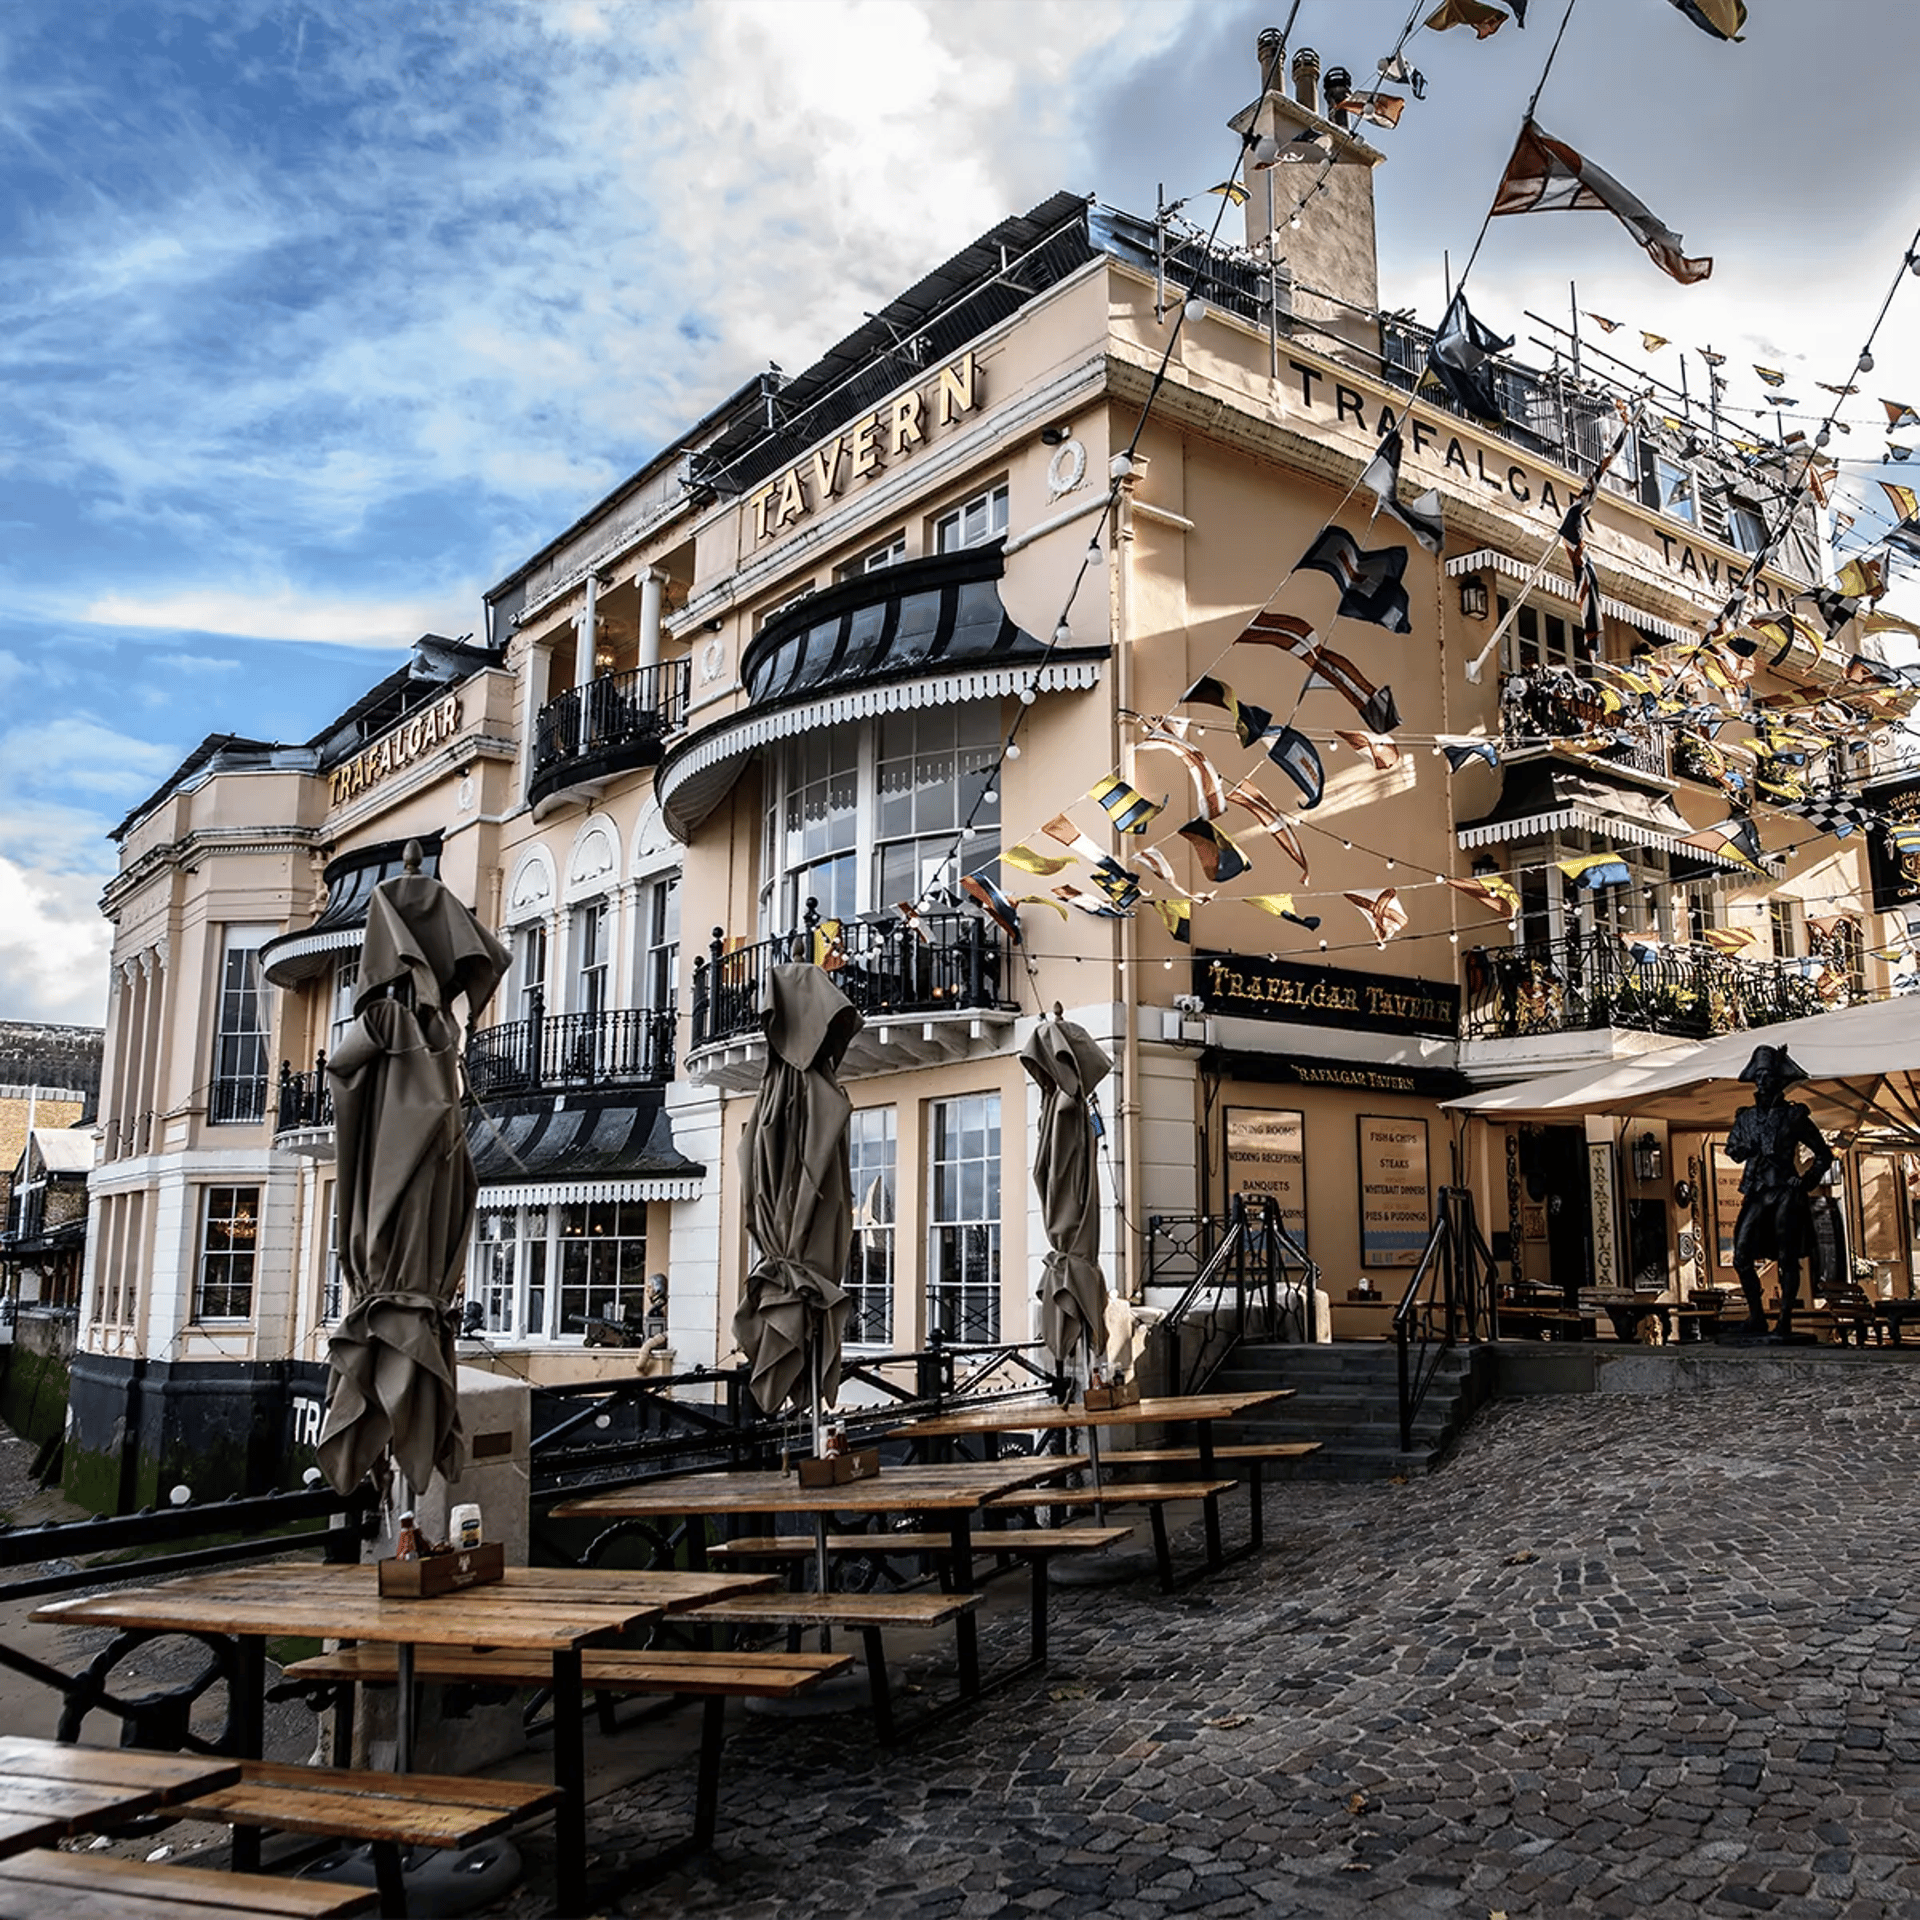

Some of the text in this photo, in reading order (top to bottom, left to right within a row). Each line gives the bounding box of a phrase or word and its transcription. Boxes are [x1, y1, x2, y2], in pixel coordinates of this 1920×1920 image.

[751, 350, 979, 540] TAVERN
[1654, 528, 1796, 615] TAVERN
[329, 696, 459, 808] TRAFALGAR
[1208, 965, 1452, 1022] TRAFALGAR TAVERN
[1367, 1071, 1415, 1090] TAVERN
[1266, 1125, 1297, 1136] ROOMS
[1370, 1131, 1388, 1142] FISH
[1395, 1133, 1417, 1143] CHIPS
[1228, 1151, 1260, 1162] WEDDING
[1380, 1158, 1410, 1169] STEAKS
[1243, 1180, 1290, 1192] BANQUETS
[1401, 1185, 1427, 1195] DINNERS
[1365, 1211, 1427, 1222] PIES & PUDDINGS
[1592, 1148, 1614, 1287] TRAFALGA
